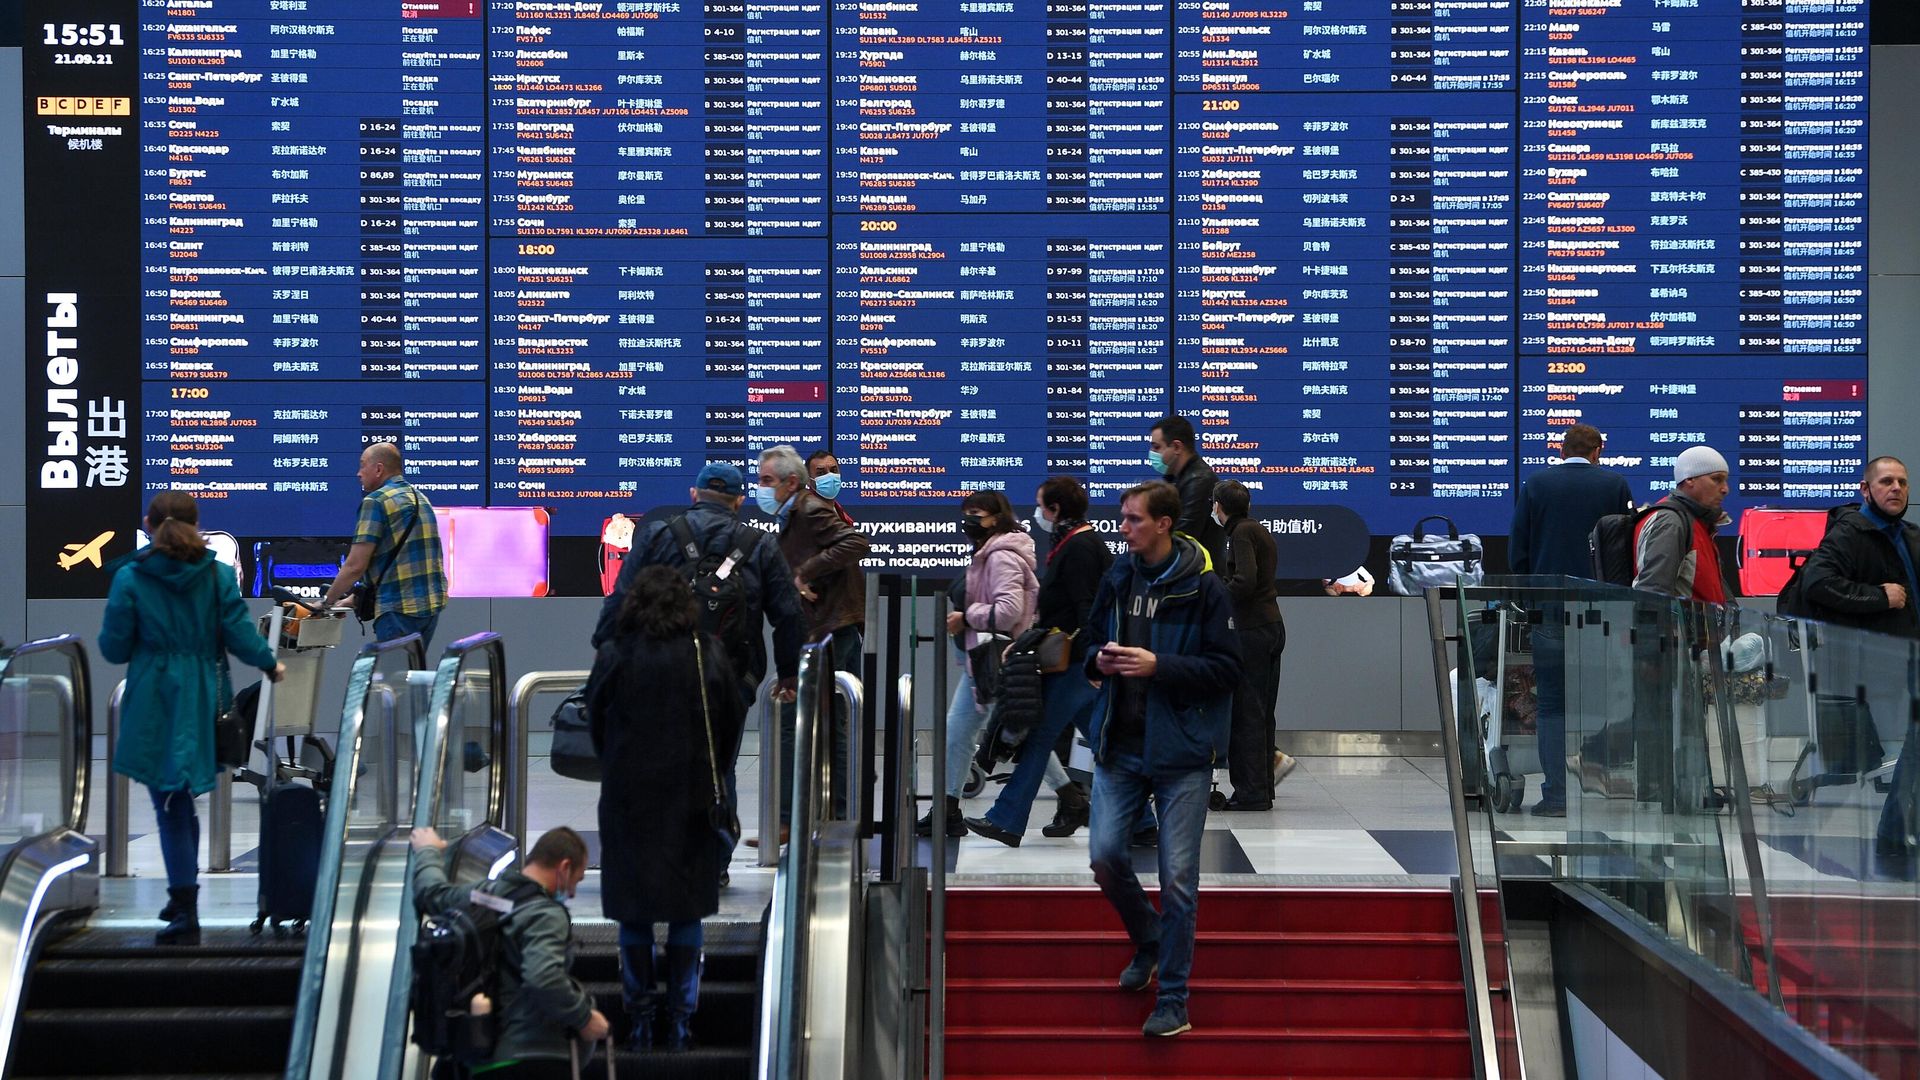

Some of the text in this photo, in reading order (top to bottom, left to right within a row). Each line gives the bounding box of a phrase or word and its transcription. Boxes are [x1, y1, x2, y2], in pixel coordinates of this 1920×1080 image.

[143, 24, 237, 34] 16:20 Архангельск
[516, 26, 551, 37] Пафос
[705, 28, 734, 36] D 4-10
[860, 27, 898, 35] Казань
[43, 24, 124, 46] 15:51
[55, 54, 113, 64] 21.09.21
[516, 50, 568, 59] Лиссабон
[859, 51, 903, 62] Хургада
[168, 72, 263, 83] Санкт-Петербург
[1203, 74, 1247, 85] Барнаул
[40, 99, 122, 109] B C D E F
[860, 99, 912, 110] Белгород
[1203, 100, 1239, 110] 21:00
[1548, 96, 1578, 104] Омск
[144, 120, 196, 129] 16:35 Сочи
[360, 123, 395, 131] D 16-24
[517, 122, 574, 133] Волгоград
[47, 125, 122, 137] Терминалы
[68, 139, 103, 150] 候机楼
[1523, 168, 1587, 179] 22:40 Бухара
[169, 193, 214, 204] Саратов
[517, 194, 570, 205] Оренбург
[860, 195, 907, 206] Магадан
[1202, 194, 1263, 205] Череповец
[861, 221, 897, 231] 20:00
[1523, 216, 1604, 227] 22:45 Кемерово
[519, 245, 554, 254] 18:00
[1202, 242, 1241, 253] Бейрут
[860, 266, 917, 275] Хельсинки
[170, 289, 221, 299] Воронеж
[517, 290, 570, 298] Аликанте
[860, 314, 896, 322] Минск
[146, 337, 248, 348] 16:50 Симферополь
[1178, 337, 1244, 346] 21:30 Бишкек
[1390, 339, 1397, 347] D
[1202, 361, 1258, 372] Астрахань
[1548, 363, 1585, 373] 23:00
[41, 292, 79, 489] Вылеты
[172, 388, 208, 398] 17:00
[518, 386, 573, 397] Мин.Воды
[1523, 384, 1624, 395] 23:00 Екатеринбург
[1523, 408, 1582, 417] 23:00 Анапа
[1739, 410, 1745, 418] B
[84, 396, 129, 488] 出港
[170, 434, 234, 445] Амстердам
[853, 521, 957, 536] служивания
